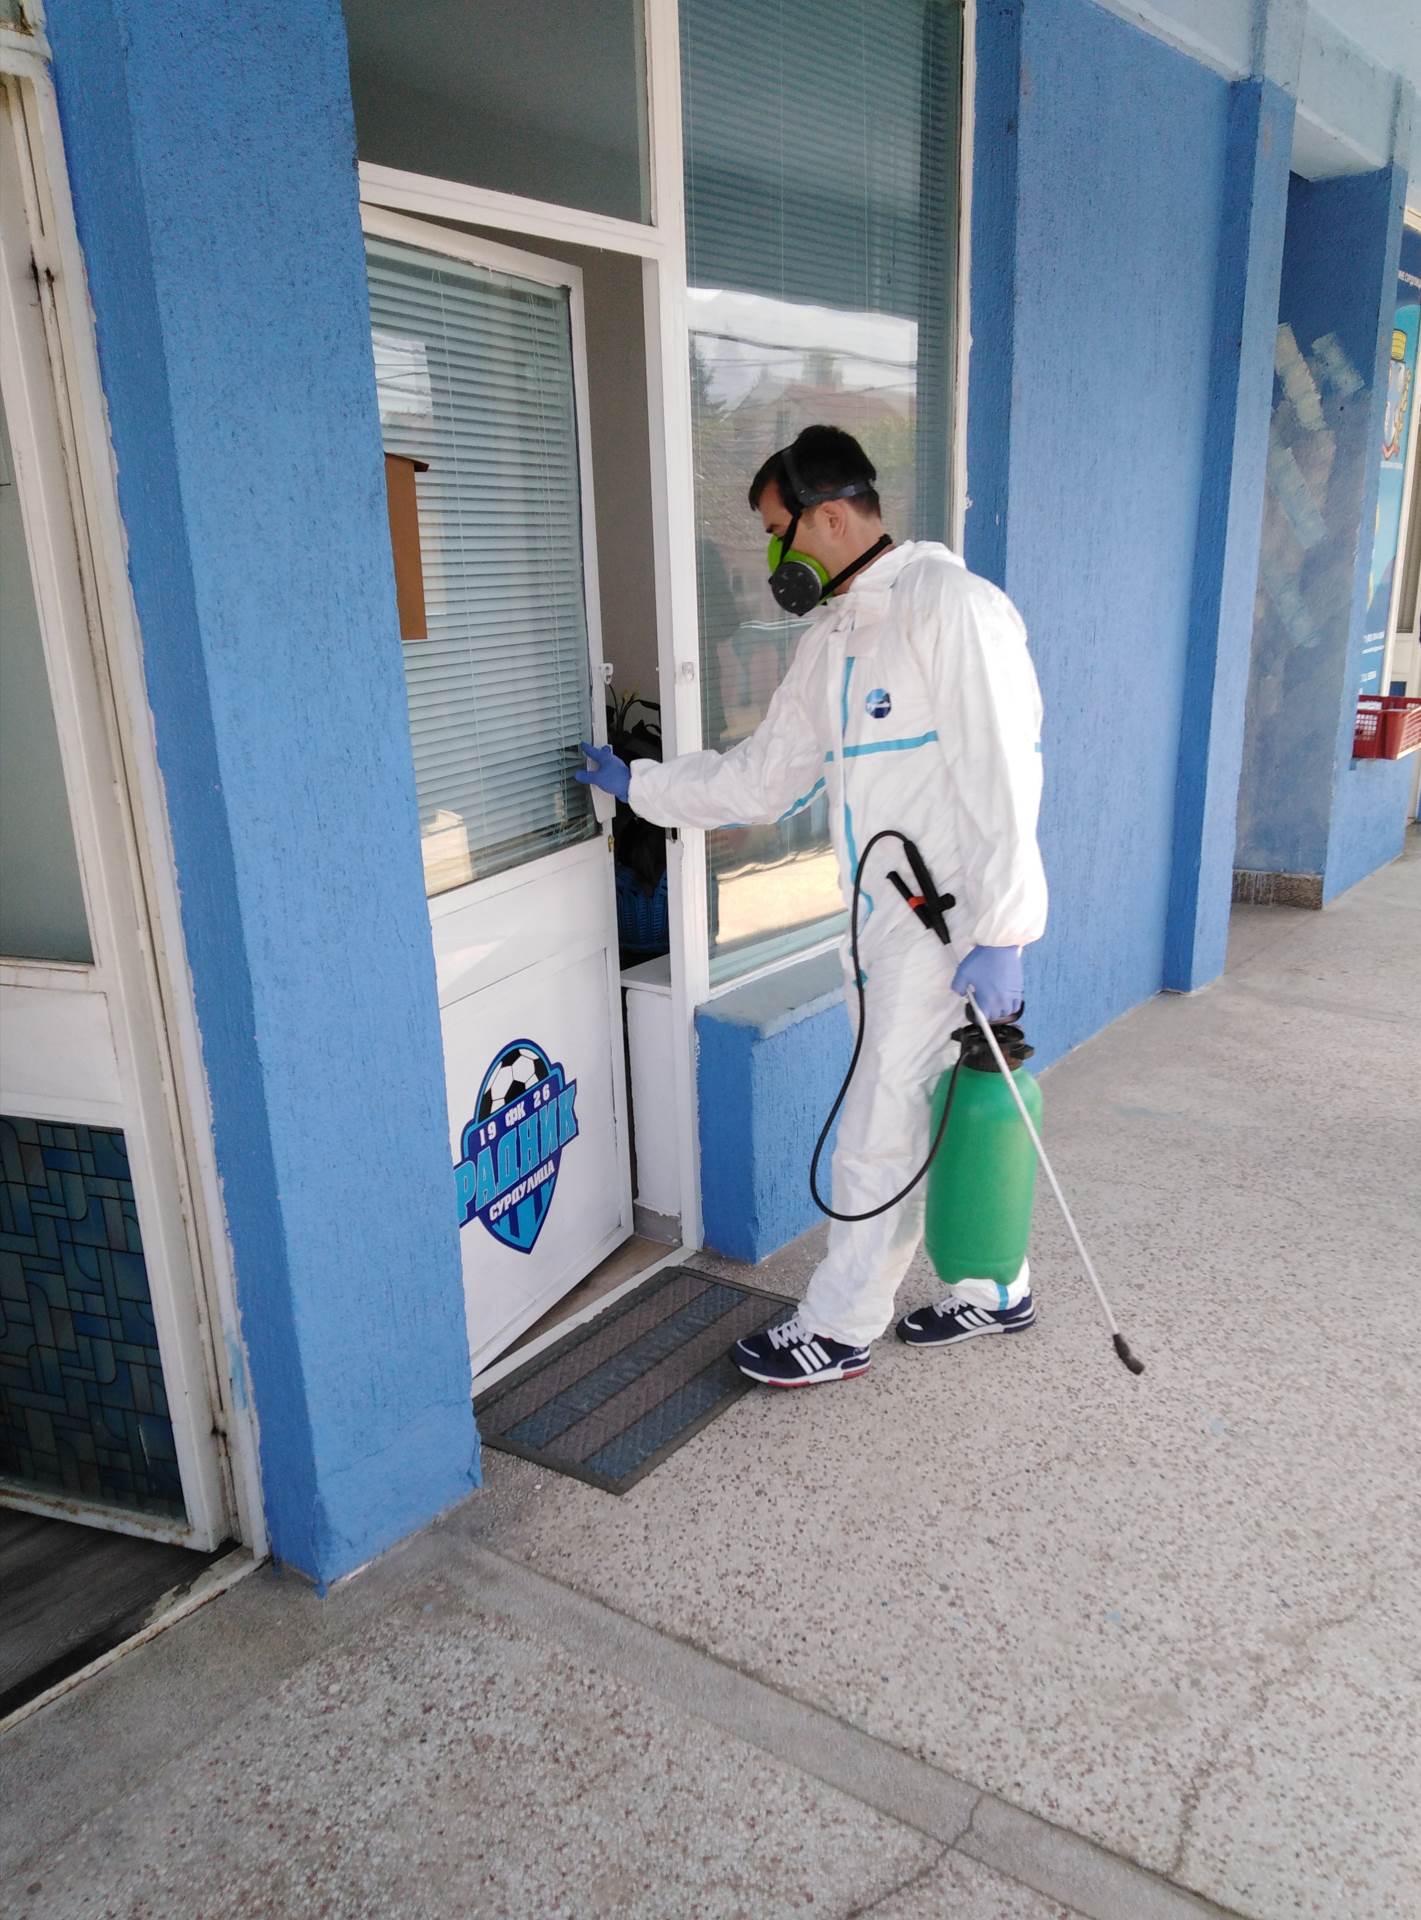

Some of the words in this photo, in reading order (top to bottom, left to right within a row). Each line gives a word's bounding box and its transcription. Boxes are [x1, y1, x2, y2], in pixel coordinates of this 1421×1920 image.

[479, 1120, 497, 1146] 19
[505, 1101, 526, 1126] ФК
[533, 1084, 550, 1109] 26
[453, 1084, 577, 1223] РАДНИК
[489, 1160, 555, 1220] СУРДУЛИЦА
